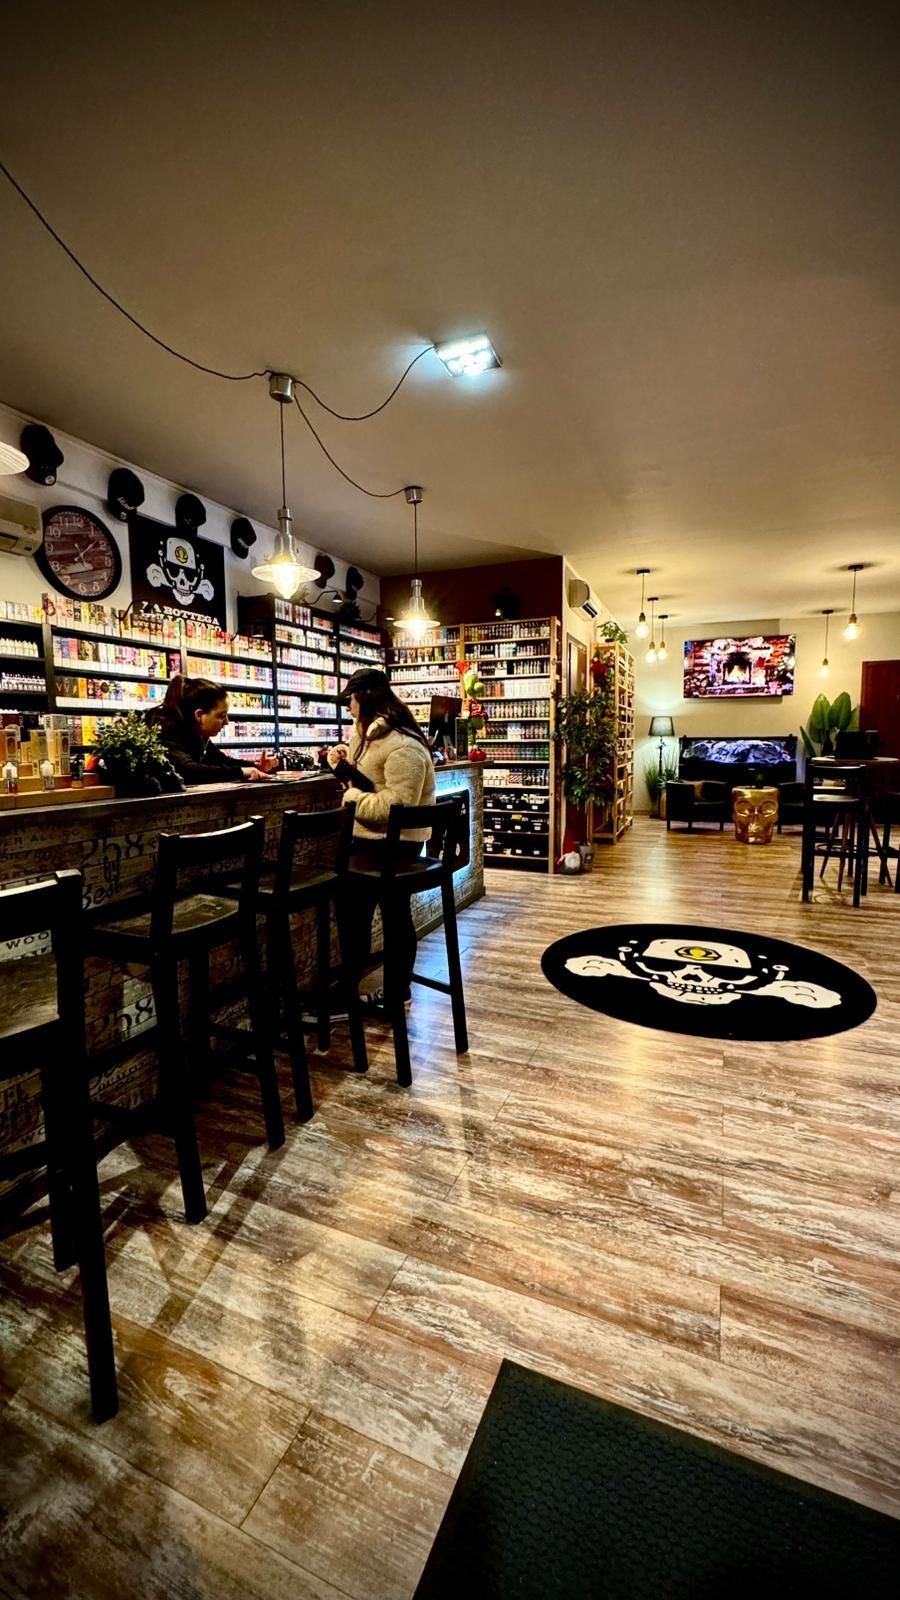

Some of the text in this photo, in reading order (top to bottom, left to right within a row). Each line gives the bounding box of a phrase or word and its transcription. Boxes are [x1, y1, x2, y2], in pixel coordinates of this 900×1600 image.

[48, 525, 61, 538] 10
[46, 542, 54, 552] 9
[100, 540, 107, 551] 2
[51, 560, 60, 571] 8
[62, 575, 71, 586] 7
[78, 582, 87, 593] 6
[163, 605, 221, 626] BOTTEGA
